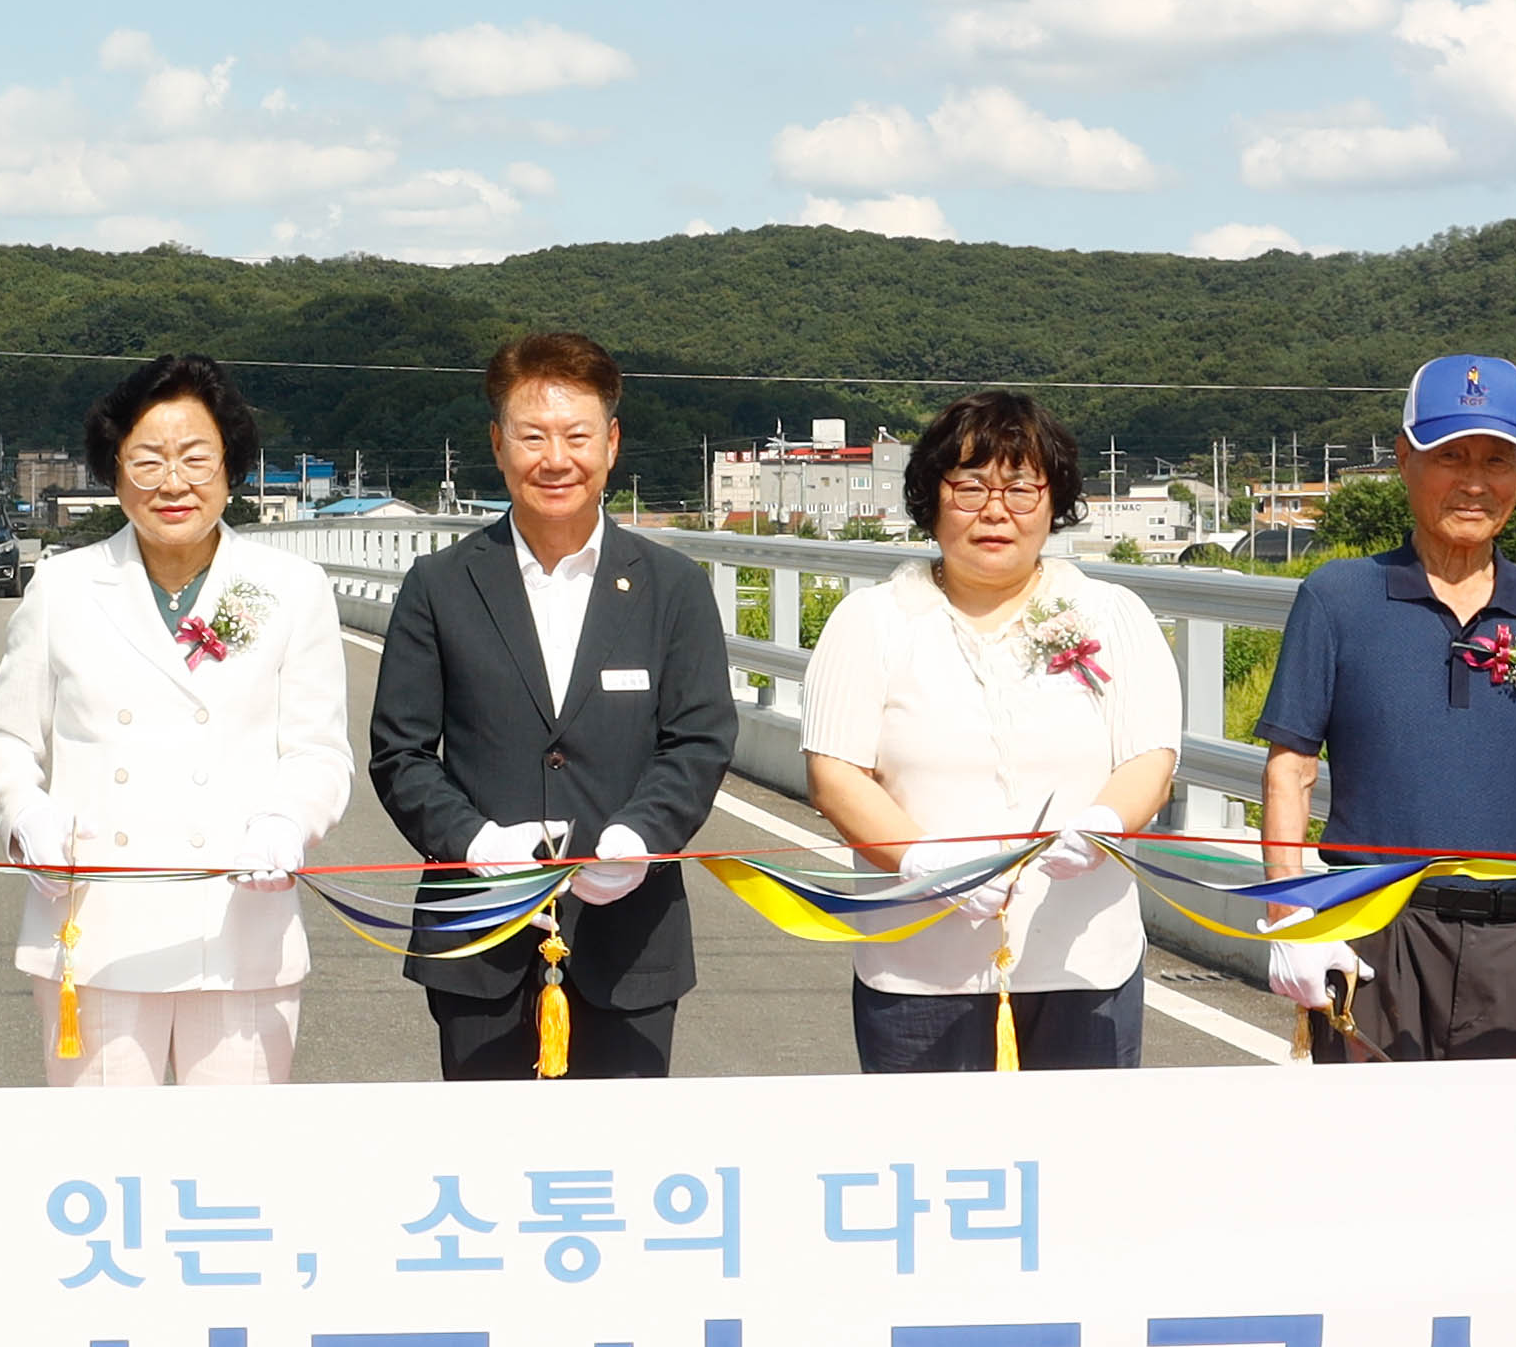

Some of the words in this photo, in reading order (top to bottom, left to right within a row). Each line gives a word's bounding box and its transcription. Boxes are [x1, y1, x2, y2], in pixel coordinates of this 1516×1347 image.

[48, 1177, 316, 1287] 잇는,
[397, 1168, 739, 1282] 소통의
[818, 1162, 1038, 1273] 다리
